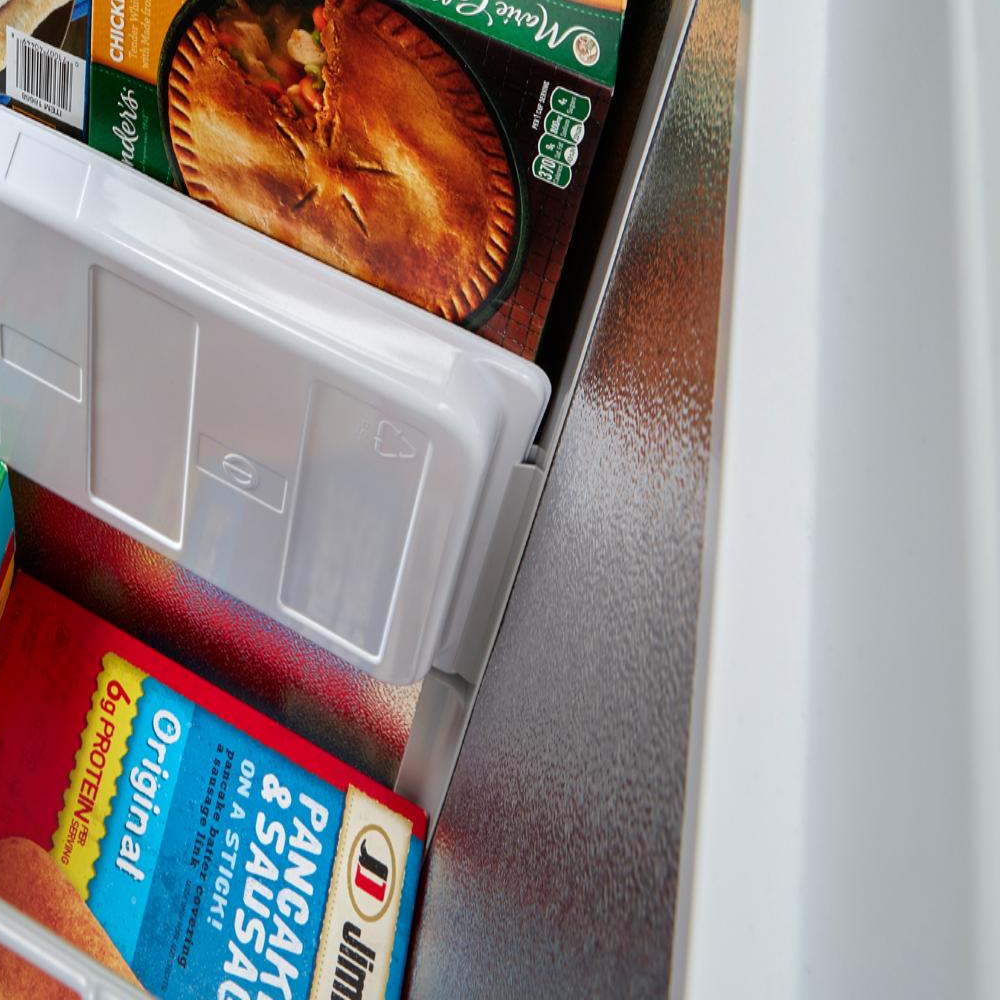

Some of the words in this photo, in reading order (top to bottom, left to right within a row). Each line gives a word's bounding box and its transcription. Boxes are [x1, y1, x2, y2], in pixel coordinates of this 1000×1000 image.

[127, 22, 138, 59] Tender
[139, 15, 151, 46] Made
[138, 45, 149, 69] with
[42, 103, 63, 116] ITEM
[538, 79, 549, 103] SERVING
[566, 95, 577, 114] Sugars
[537, 157, 556, 180] 370
[100, 679, 131, 716] 6g
[73, 716, 115, 826] PROTEIN
[212, 747, 235, 822] pancake
[236, 758, 256, 799] ON
[115, 708, 182, 882] Original
[199, 758, 222, 827] sausage
[260, 773, 292, 810] &
[229, 801, 246, 820] A
[61, 818, 80, 866] SERVING
[77, 824, 89, 848] PER
[190, 830, 206, 869] link
[200, 827, 220, 883] batter
[206, 828, 240, 932] STICK!
[177, 885, 205, 969] covering
